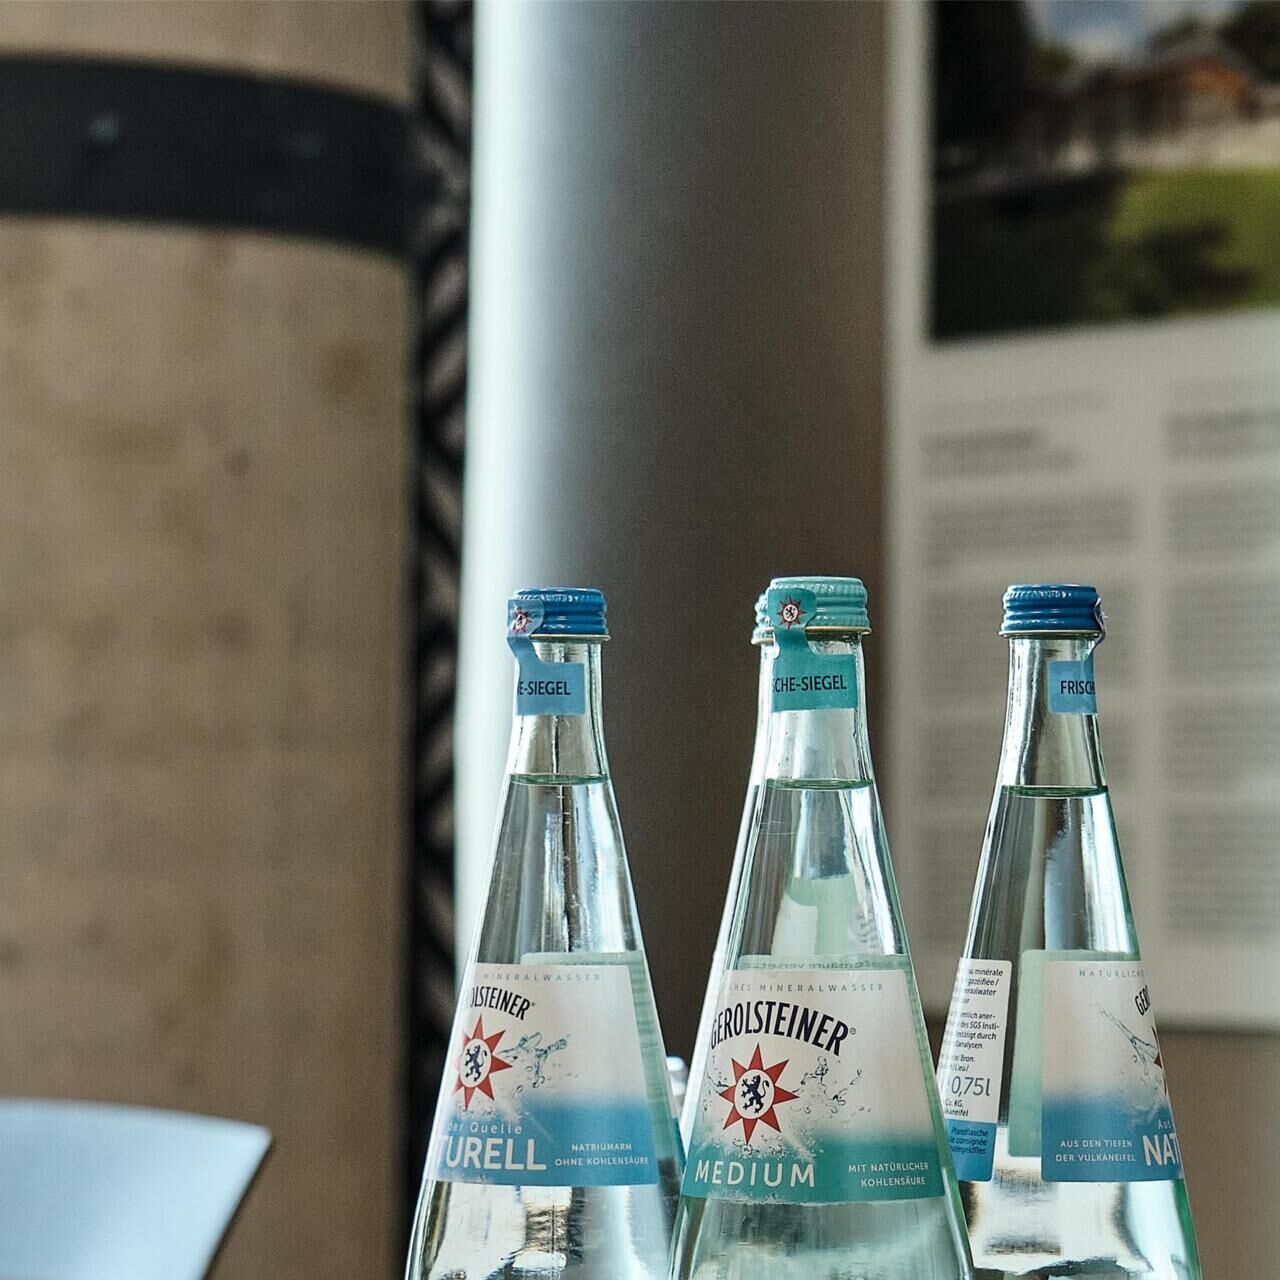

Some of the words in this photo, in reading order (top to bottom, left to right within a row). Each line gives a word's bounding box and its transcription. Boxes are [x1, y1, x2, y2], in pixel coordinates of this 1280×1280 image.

[759, 983, 885, 993] MINERALWASSER
[969, 1021, 981, 1030] SGS
[976, 1031, 997, 1041] durch
[951, 1075, 991, 1097] 0,75l
[470, 1122, 523, 1135] Quelle
[571, 1143, 632, 1152] NATRIUMARM
[1060, 1139, 1079, 1148] AUS
[1082, 1139, 1101, 1148] DEN
[1104, 1139, 1132, 1148] TIEFEN
[555, 1158, 583, 1167] OHNE
[1055, 1154, 1074, 1162] DER
[1077, 1154, 1136, 1162] VULKANEIFEL
[848, 1164, 866, 1173] MIT
[871, 1162, 929, 1172] NATÜRLICHER
[695, 1159, 815, 1188] MEDIUM
[861, 1176, 926, 1187] KOHLENSÄURE
